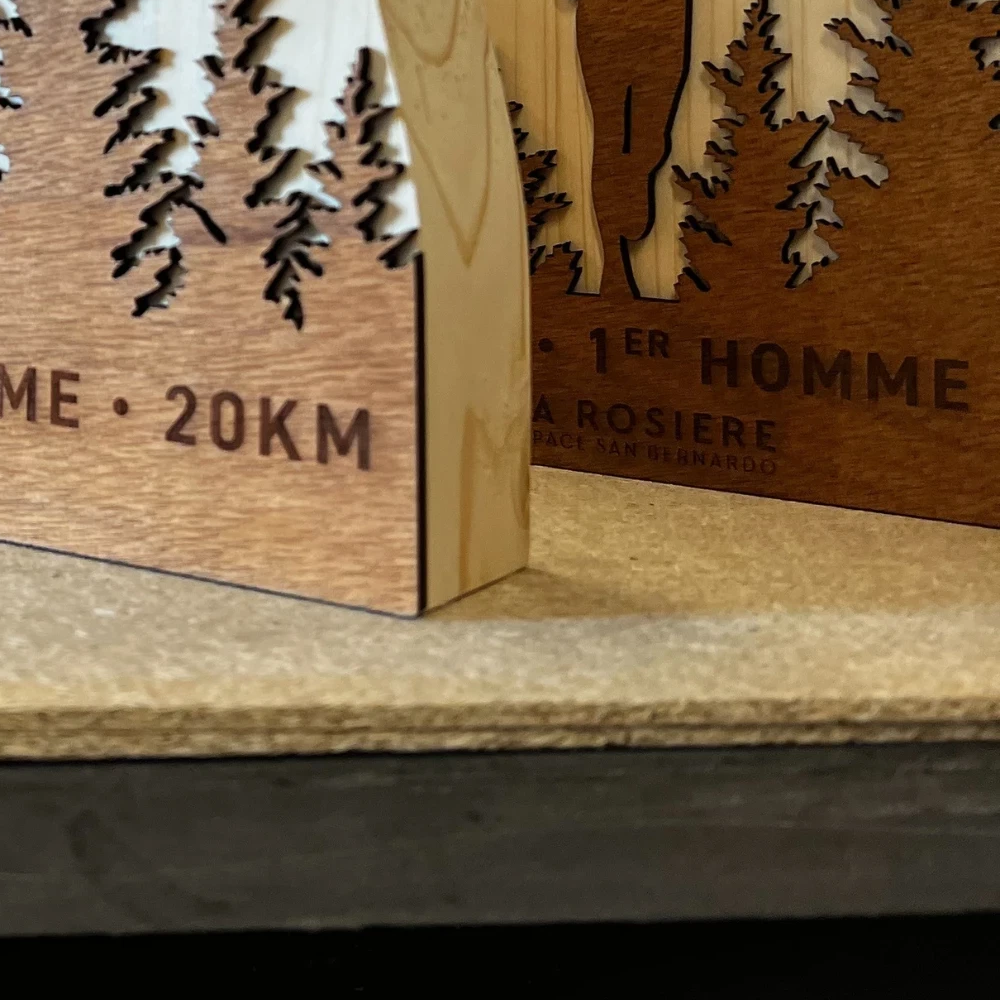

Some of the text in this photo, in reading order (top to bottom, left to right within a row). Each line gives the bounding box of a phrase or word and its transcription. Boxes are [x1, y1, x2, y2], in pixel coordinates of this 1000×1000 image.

[701, 337, 970, 412] HOMME
[164, 384, 372, 472] 20KM
[532, 393, 777, 453] A ROSIERE
[532, 429, 585, 450] PACE
[647, 446, 777, 475] BERNARDO
